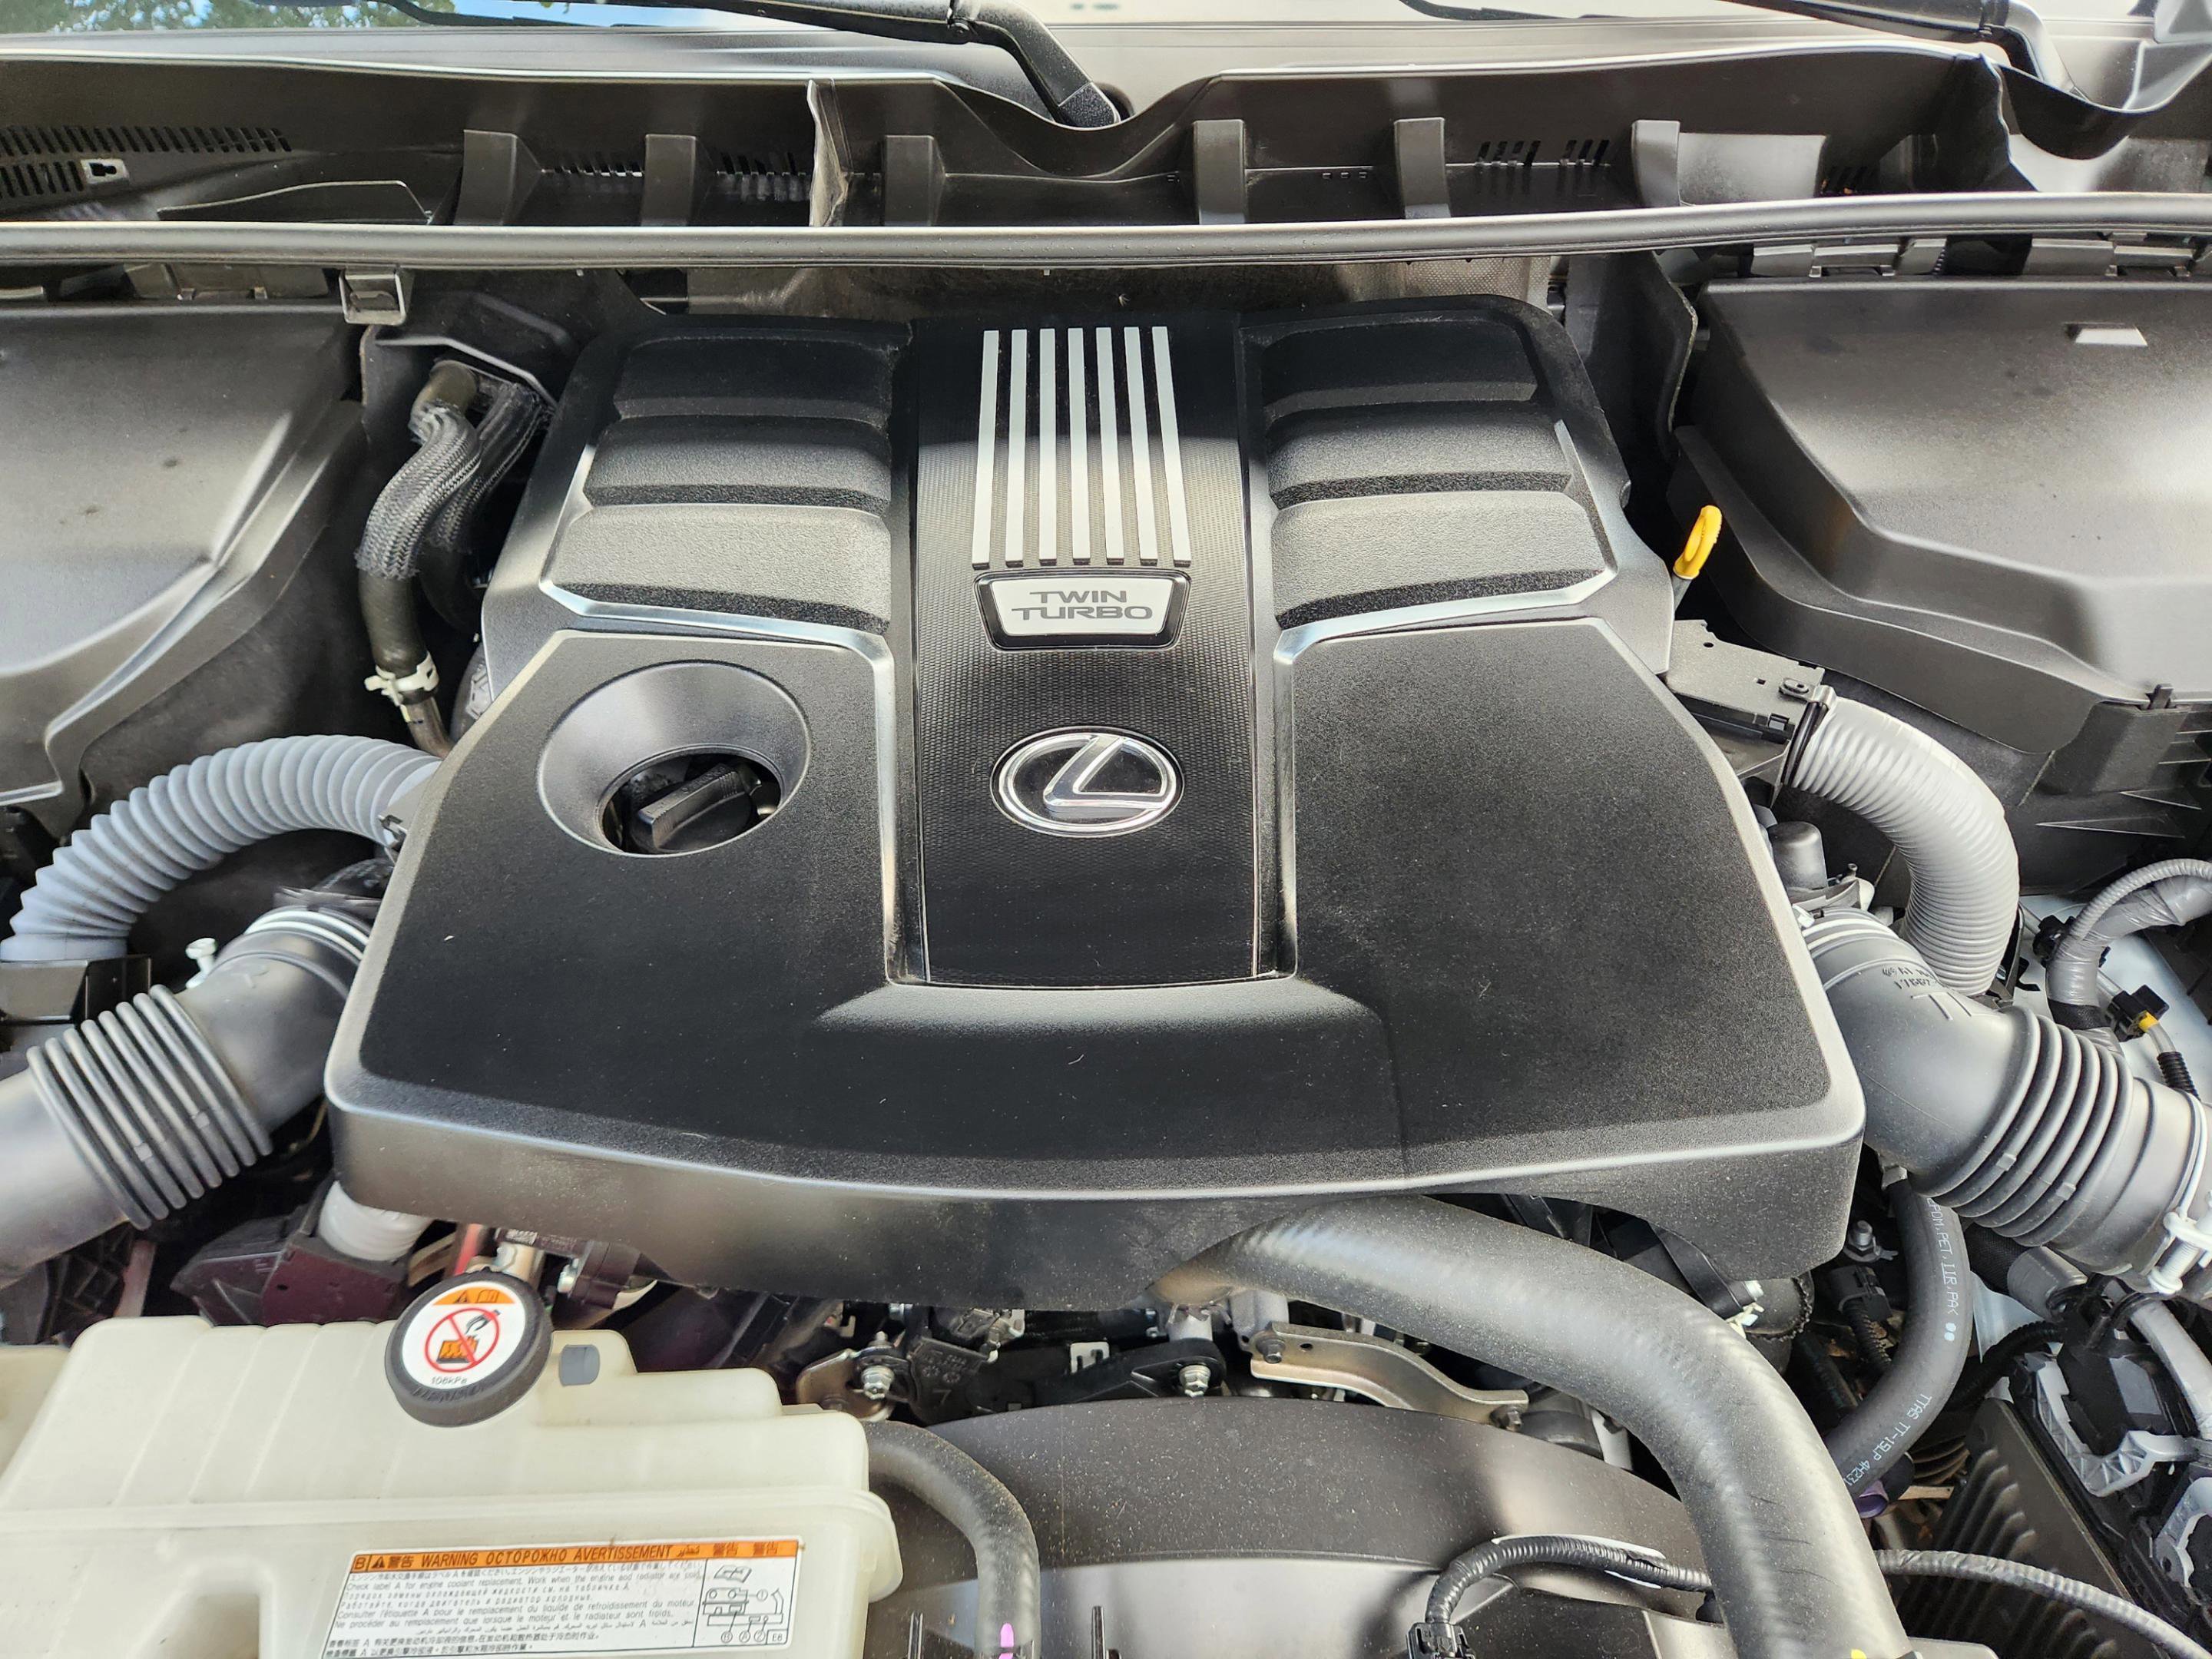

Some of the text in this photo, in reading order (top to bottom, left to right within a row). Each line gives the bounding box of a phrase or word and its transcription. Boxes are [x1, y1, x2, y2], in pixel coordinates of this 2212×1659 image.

[1030, 590, 1127, 604] TWIN
[1012, 606, 1153, 621] TURBO
[1906, 1393, 1932, 1419] TTAS
[422, 1552, 478, 1568] WARNING
[574, 1544, 674, 1561] AVERTISSEMENT
